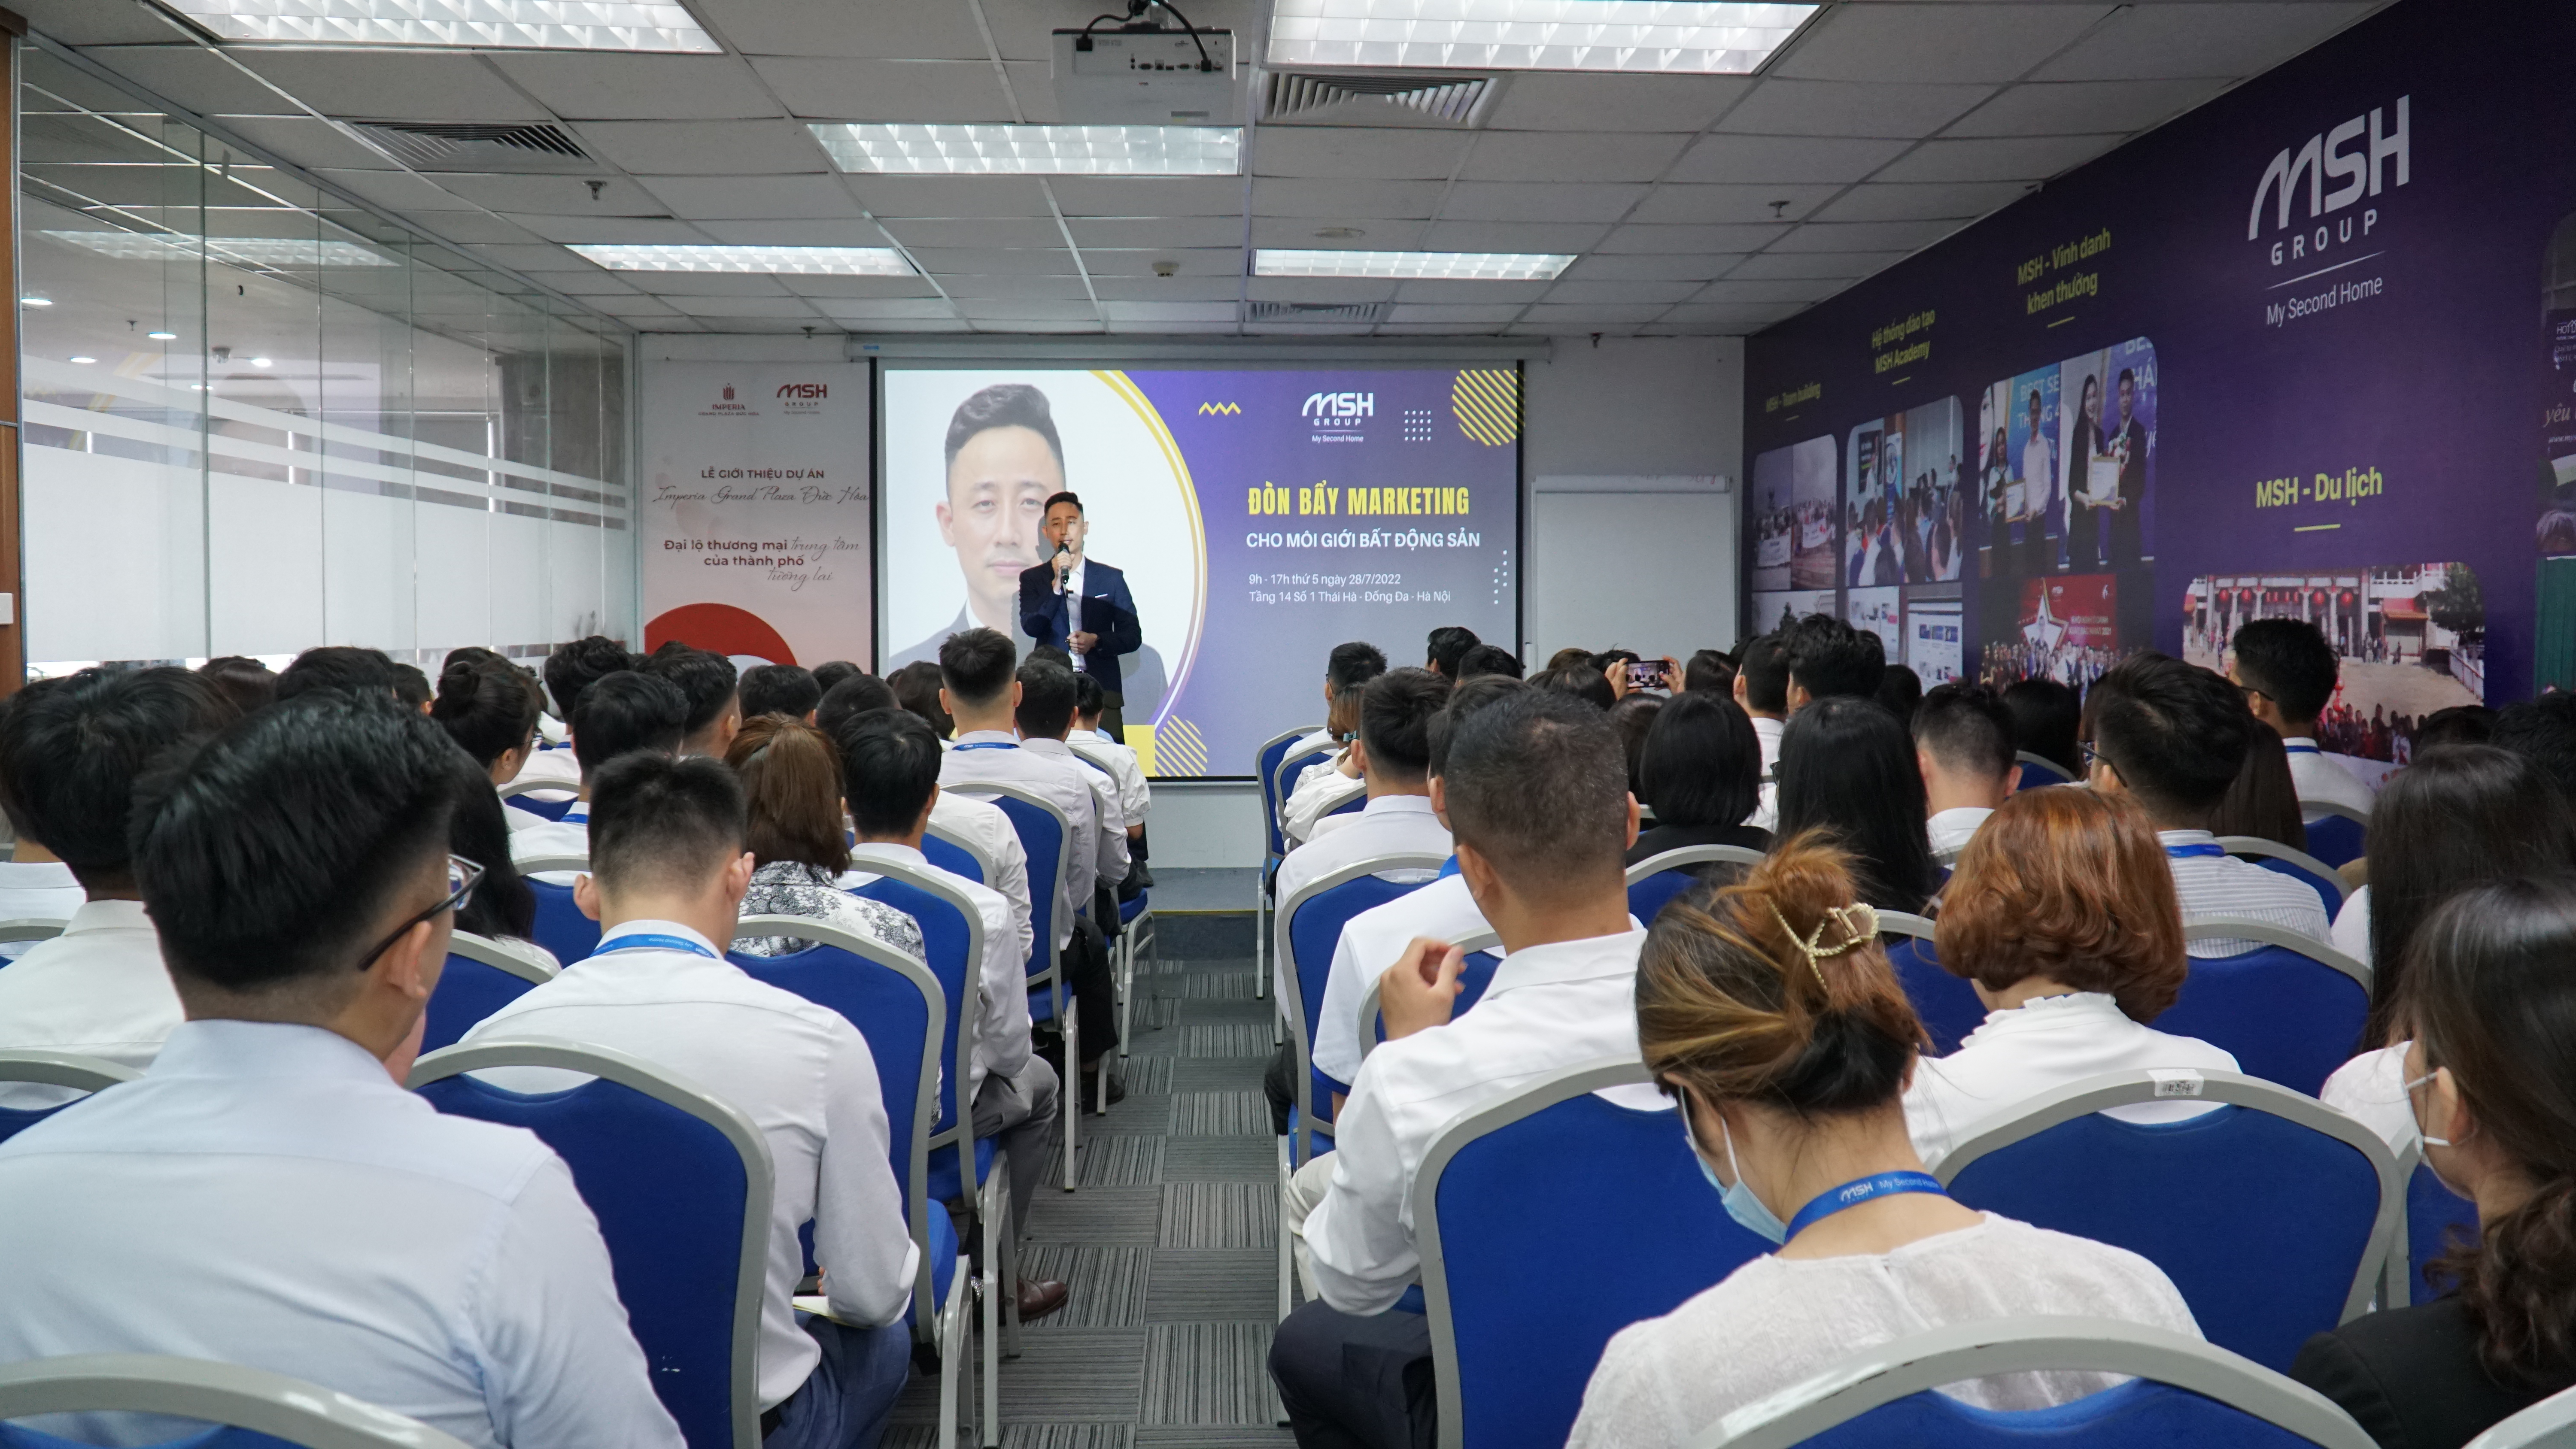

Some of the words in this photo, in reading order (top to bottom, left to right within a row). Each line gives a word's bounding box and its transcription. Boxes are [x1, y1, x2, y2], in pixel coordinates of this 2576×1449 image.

[2248, 94, 2409, 241] MSH
[2271, 208, 2378, 266] GROUP
[2017, 255, 2043, 285] MSH
[2080, 227, 2111, 258] danh
[2027, 291, 2054, 314] khen
[2266, 303, 2285, 327] My
[2288, 285, 2336, 319] Second
[2341, 277, 2382, 304] Home
[1921, 309, 1935, 331] tạo
[1875, 351, 1893, 374] MSH
[1893, 341, 1930, 368] Academy
[776, 384, 827, 398] MSH
[1302, 392, 1373, 416] MSH
[1312, 435, 1321, 443] My
[701, 466, 715, 478] LỄ
[718, 467, 743, 478] GIỚI
[747, 467, 782, 480] THIỆU
[786, 468, 804, 480] DỰ
[807, 468, 824, 478] ÁN
[653, 485, 707, 509] Imperia
[711, 485, 758, 504] Grand
[760, 486, 795, 500] Plaza
[1248, 480, 1290, 515] ĐÒN
[1299, 479, 1339, 515] BẨY
[1348, 487, 1469, 515] MARKETING
[2256, 476, 2298, 508] MSH
[2315, 473, 2342, 501] Du
[2345, 466, 2382, 506] lịch
[664, 539, 687, 552] Đại
[692, 540, 703, 552] lộ
[707, 540, 757, 552] thương
[762, 540, 787, 552] mại
[791, 536, 828, 561] trung
[833, 536, 860, 550] tâm
[1246, 533, 1282, 548] CHO
[1286, 530, 1317, 548] MÔI
[1321, 528, 1355, 548] GIỚI
[1360, 527, 1391, 547] BẤT
[1394, 528, 1444, 551] ĐỘNG
[1447, 527, 1480, 547] SẢN
[704, 554, 729, 565] của
[732, 555, 773, 565] thành
[778, 555, 805, 568] phố
[813, 566, 833, 580] lai
[1249, 573, 1262, 584] 9h
[1270, 573, 1290, 584] 17h
[1292, 573, 1310, 584] thứ
[1312, 574, 1318, 584] 5
[1321, 574, 1347, 587] ngày
[1349, 573, 1401, 585] 28/7/2022
[1249, 590, 1276, 604] Tầng
[1279, 591, 1291, 602] 14
[1294, 590, 1307, 602] Số
[1310, 591, 1315, 601] 1
[1318, 591, 1340, 602] Thái
[1343, 591, 1357, 602] Hà
[1364, 590, 1393, 604] Đống
[1395, 591, 1409, 601] Đa
[1417, 591, 1431, 601] Hà
[1434, 590, 1451, 603] Nội
[1841, 1182, 1873, 1201] MSH
[1879, 1180, 1893, 1189] My
